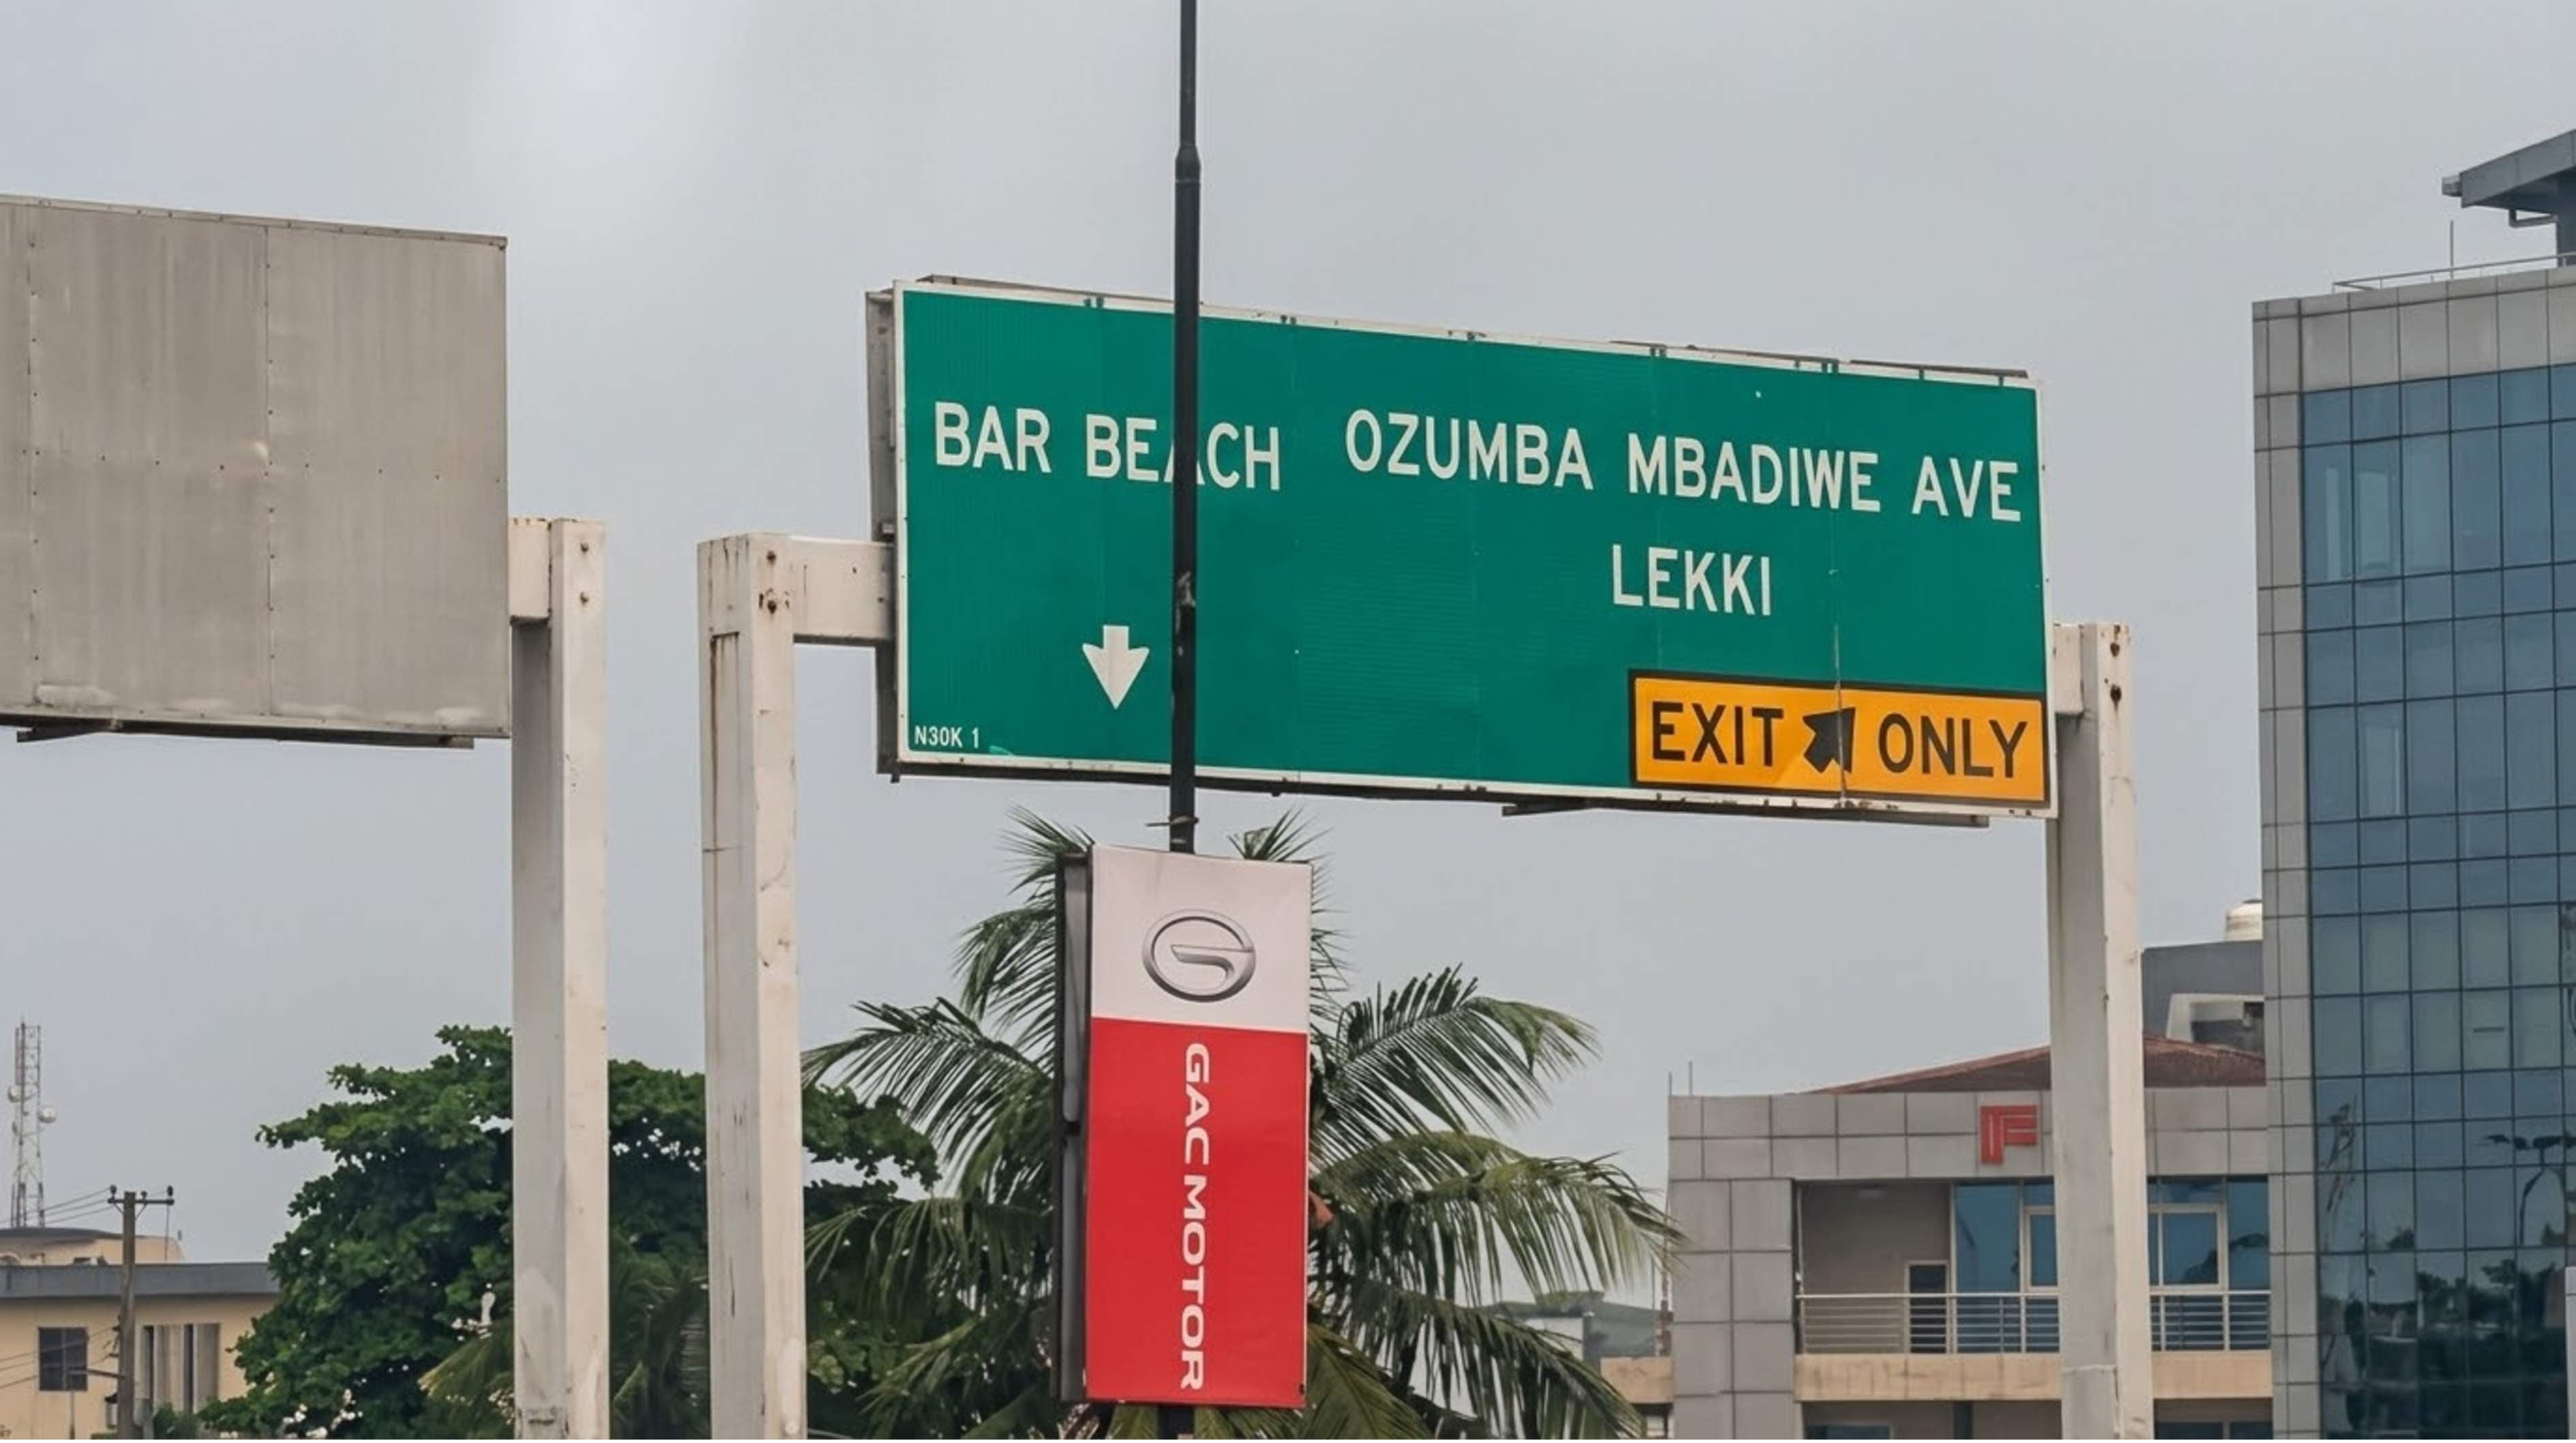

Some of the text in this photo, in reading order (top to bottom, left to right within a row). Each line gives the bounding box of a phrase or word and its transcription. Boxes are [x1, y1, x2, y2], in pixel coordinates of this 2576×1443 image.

[935, 401, 1052, 473] BAR
[1345, 409, 2021, 521] OZUMBA MBADIWE AVE
[1612, 544, 1771, 616] LEKKI
[972, 727, 979, 748] 1
[1652, 701, 2028, 779] EXIT ONLY
[1180, 1042, 1210, 1391] GAC MOTOR
